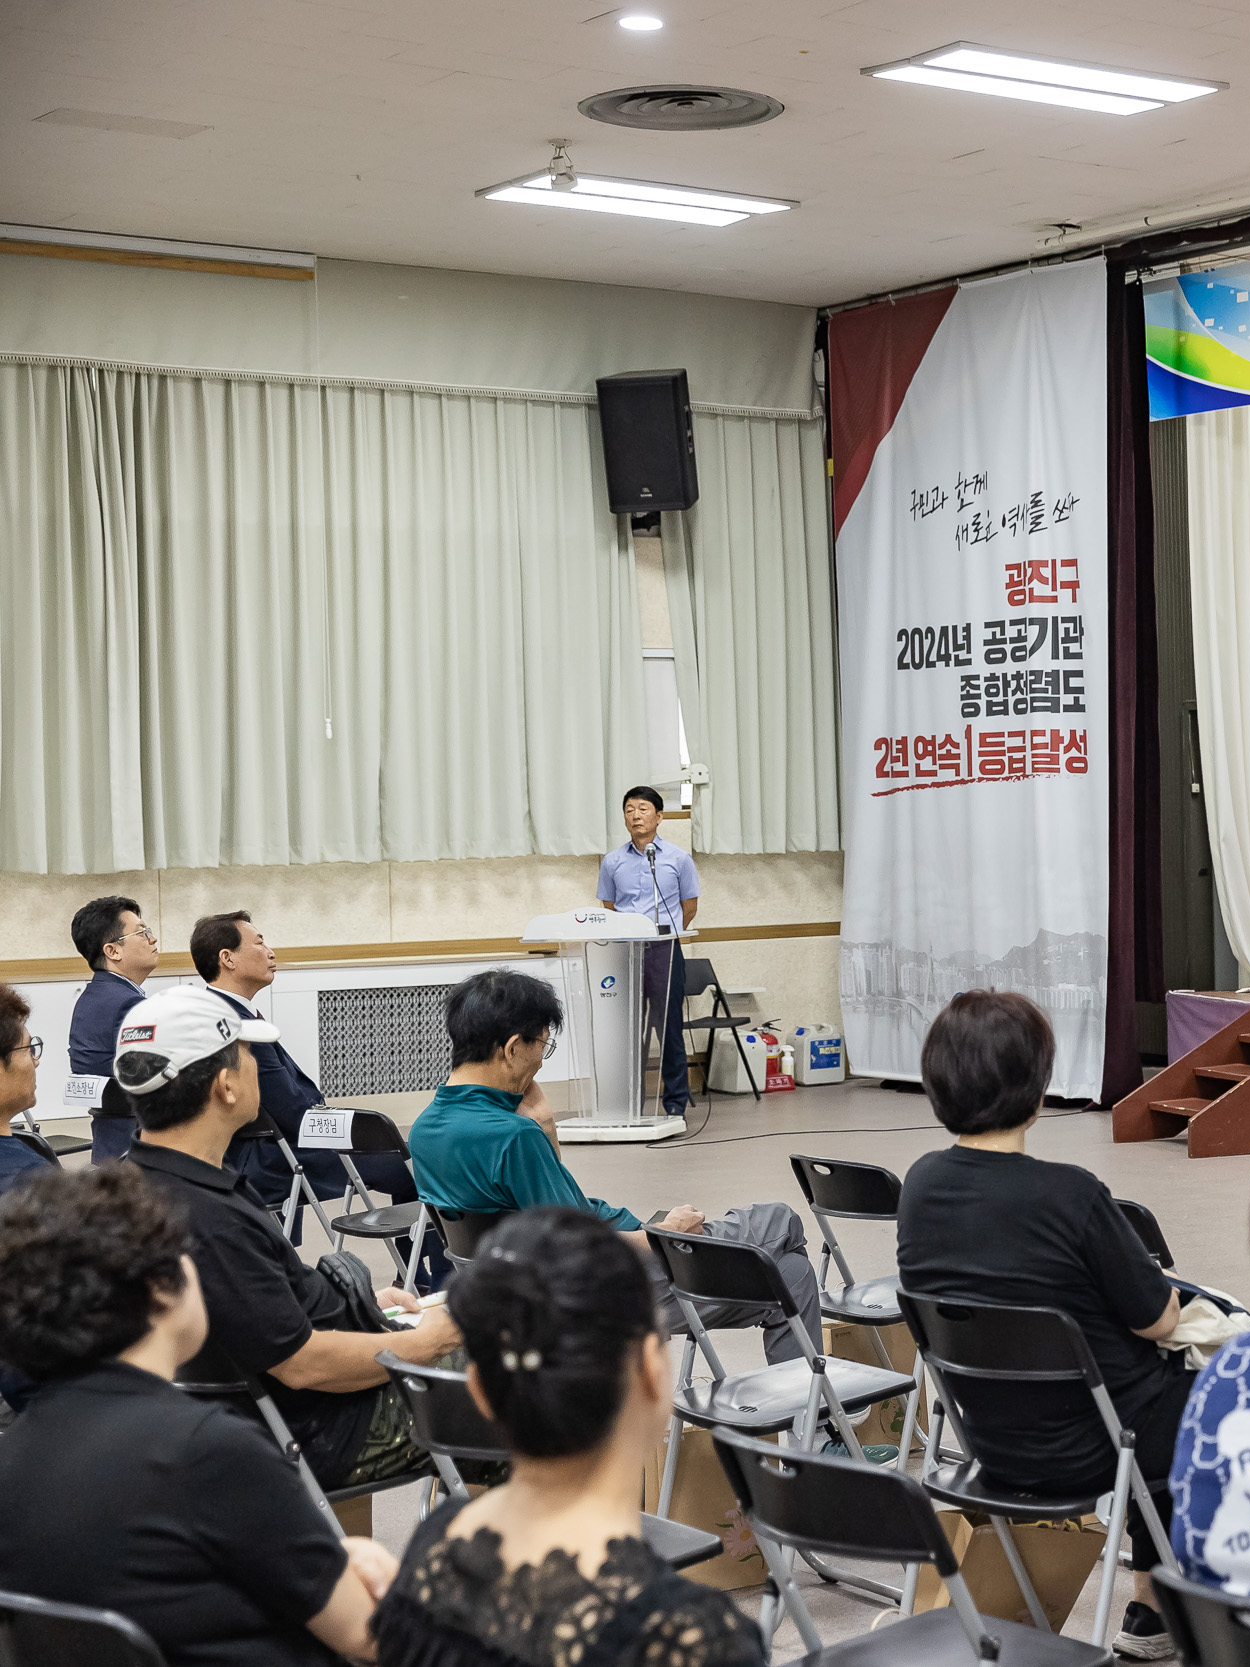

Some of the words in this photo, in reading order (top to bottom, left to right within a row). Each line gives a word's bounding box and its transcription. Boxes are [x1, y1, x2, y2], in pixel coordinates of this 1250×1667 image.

[910, 485, 949, 522] 구민과
[954, 470, 988, 513] 함께
[955, 509, 999, 551] 새로운
[1001, 490, 1048, 537] 역사를
[1004, 558, 1080, 607] 광진구
[896, 622, 973, 671] 2024년
[982, 615, 1085, 665] 공공기관
[959, 669, 1087, 719] 종합청렴도
[873, 735, 909, 779] 2년
[913, 733, 961, 778] 연속
[121, 1028, 152, 1042] Titleist
[309, 1118, 337, 1134] 구청장님
